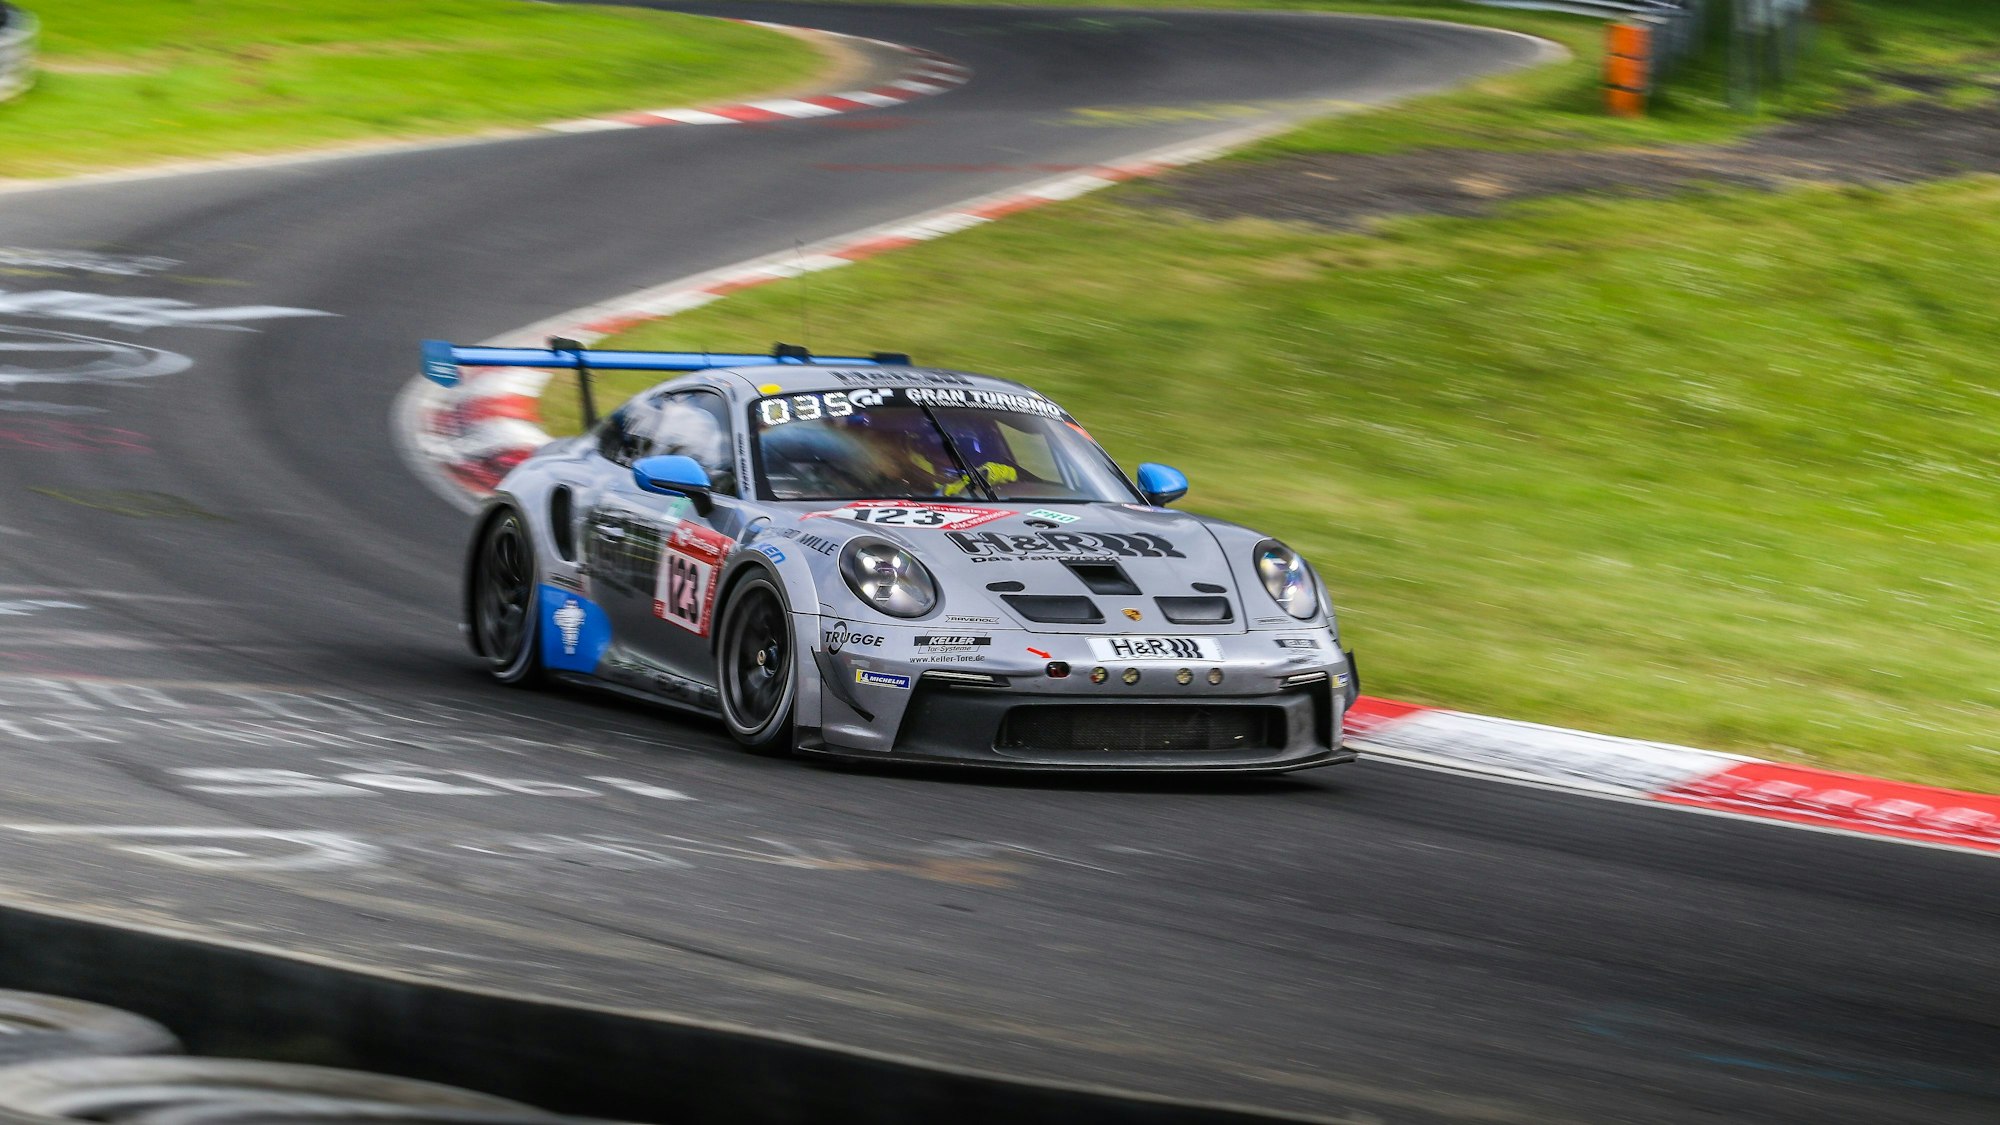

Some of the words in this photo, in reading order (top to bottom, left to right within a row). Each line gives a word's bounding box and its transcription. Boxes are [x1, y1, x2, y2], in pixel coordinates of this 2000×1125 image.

[760, 392, 853, 425] 035
[905, 388, 966, 401] GRAN
[967, 390, 1061, 417] TURISMO
[853, 509, 945, 525] 123
[800, 533, 839, 556] MILLE
[945, 531, 1107, 556] H&R
[669, 554, 699, 625] 123
[929, 636, 976, 645] KELLER
[1109, 638, 1169, 656] H&R
[909, 654, 985, 664] www.Keller-Tore.de
[869, 675, 906, 686] MICHELIN
